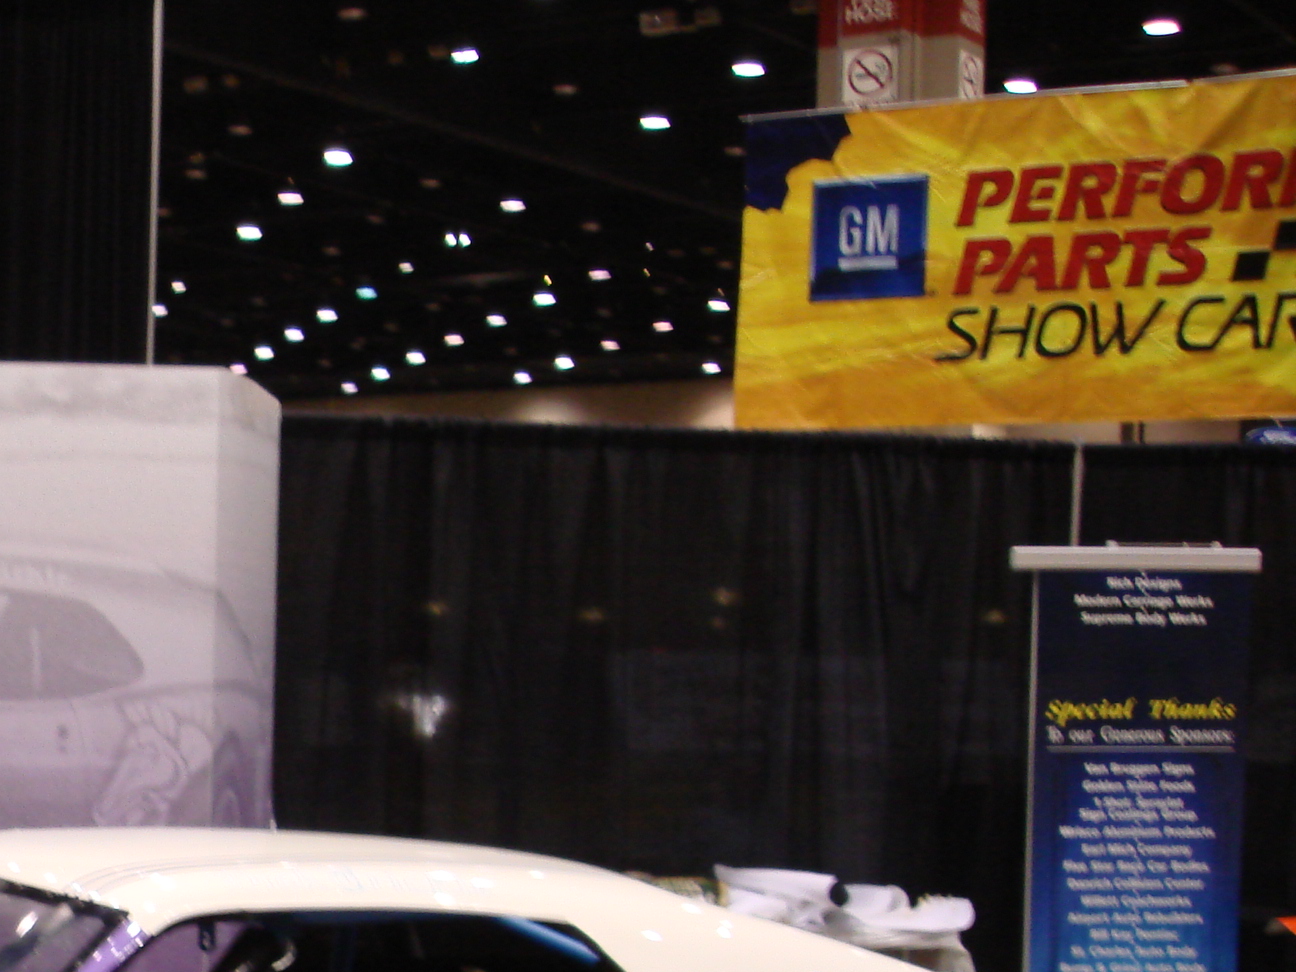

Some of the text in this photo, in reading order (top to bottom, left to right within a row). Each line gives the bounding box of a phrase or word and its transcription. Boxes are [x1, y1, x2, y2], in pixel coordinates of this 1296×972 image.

[956, 148, 1296, 228] PERFOR
[838, 205, 899, 256] GM
[953, 227, 1212, 295] PARTS
[934, 299, 1165, 363] SHOW
[1045, 697, 1237, 727] Special Thanks
